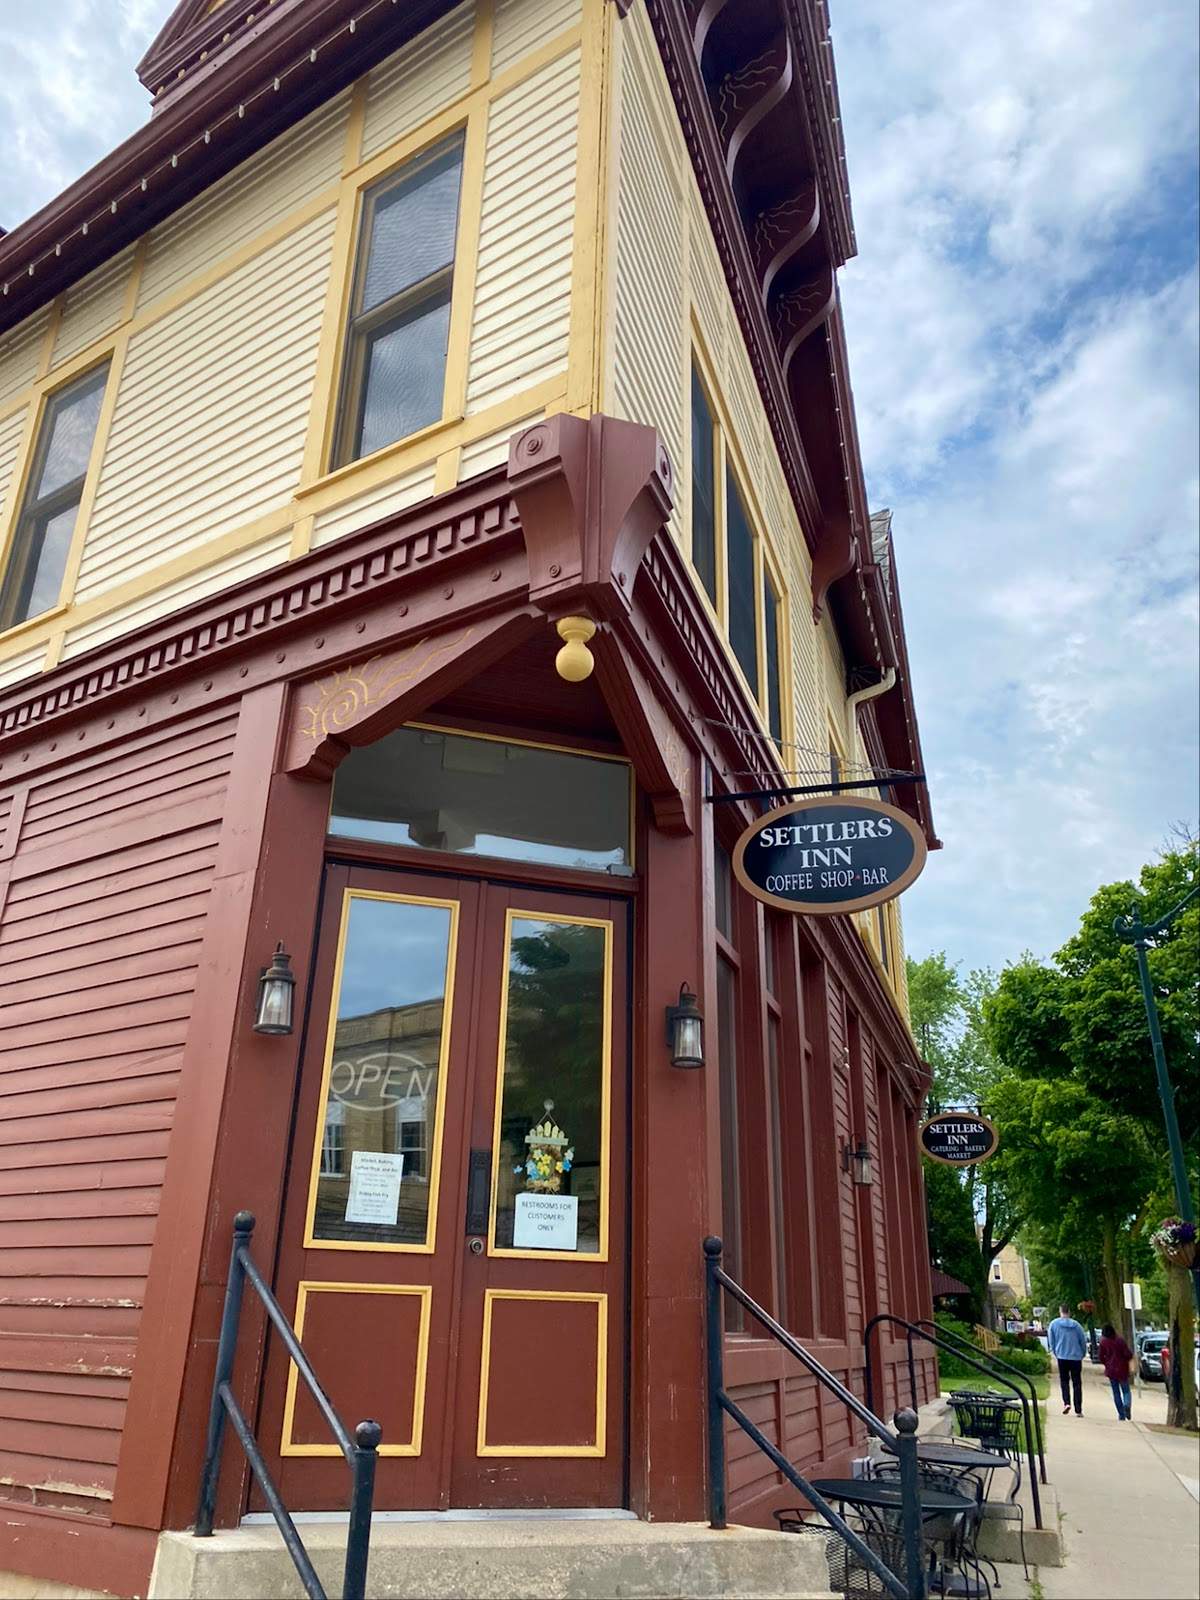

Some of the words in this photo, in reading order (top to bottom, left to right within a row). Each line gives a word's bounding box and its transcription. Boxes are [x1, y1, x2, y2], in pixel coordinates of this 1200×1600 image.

[760, 818, 893, 848] SETTLERS
[800, 846, 853, 869] INN
[766, 873, 813, 892] COFFEE
[820, 871, 854, 889] SHOP
[863, 867, 889, 885] BAR
[330, 1061, 433, 1101] OPEN
[929, 1123, 984, 1134] SETTLERS
[947, 1135, 969, 1145] INN
[522, 1201, 558, 1210] RESTROOMS
[528, 1212, 564, 1220] CUSTOMERS
